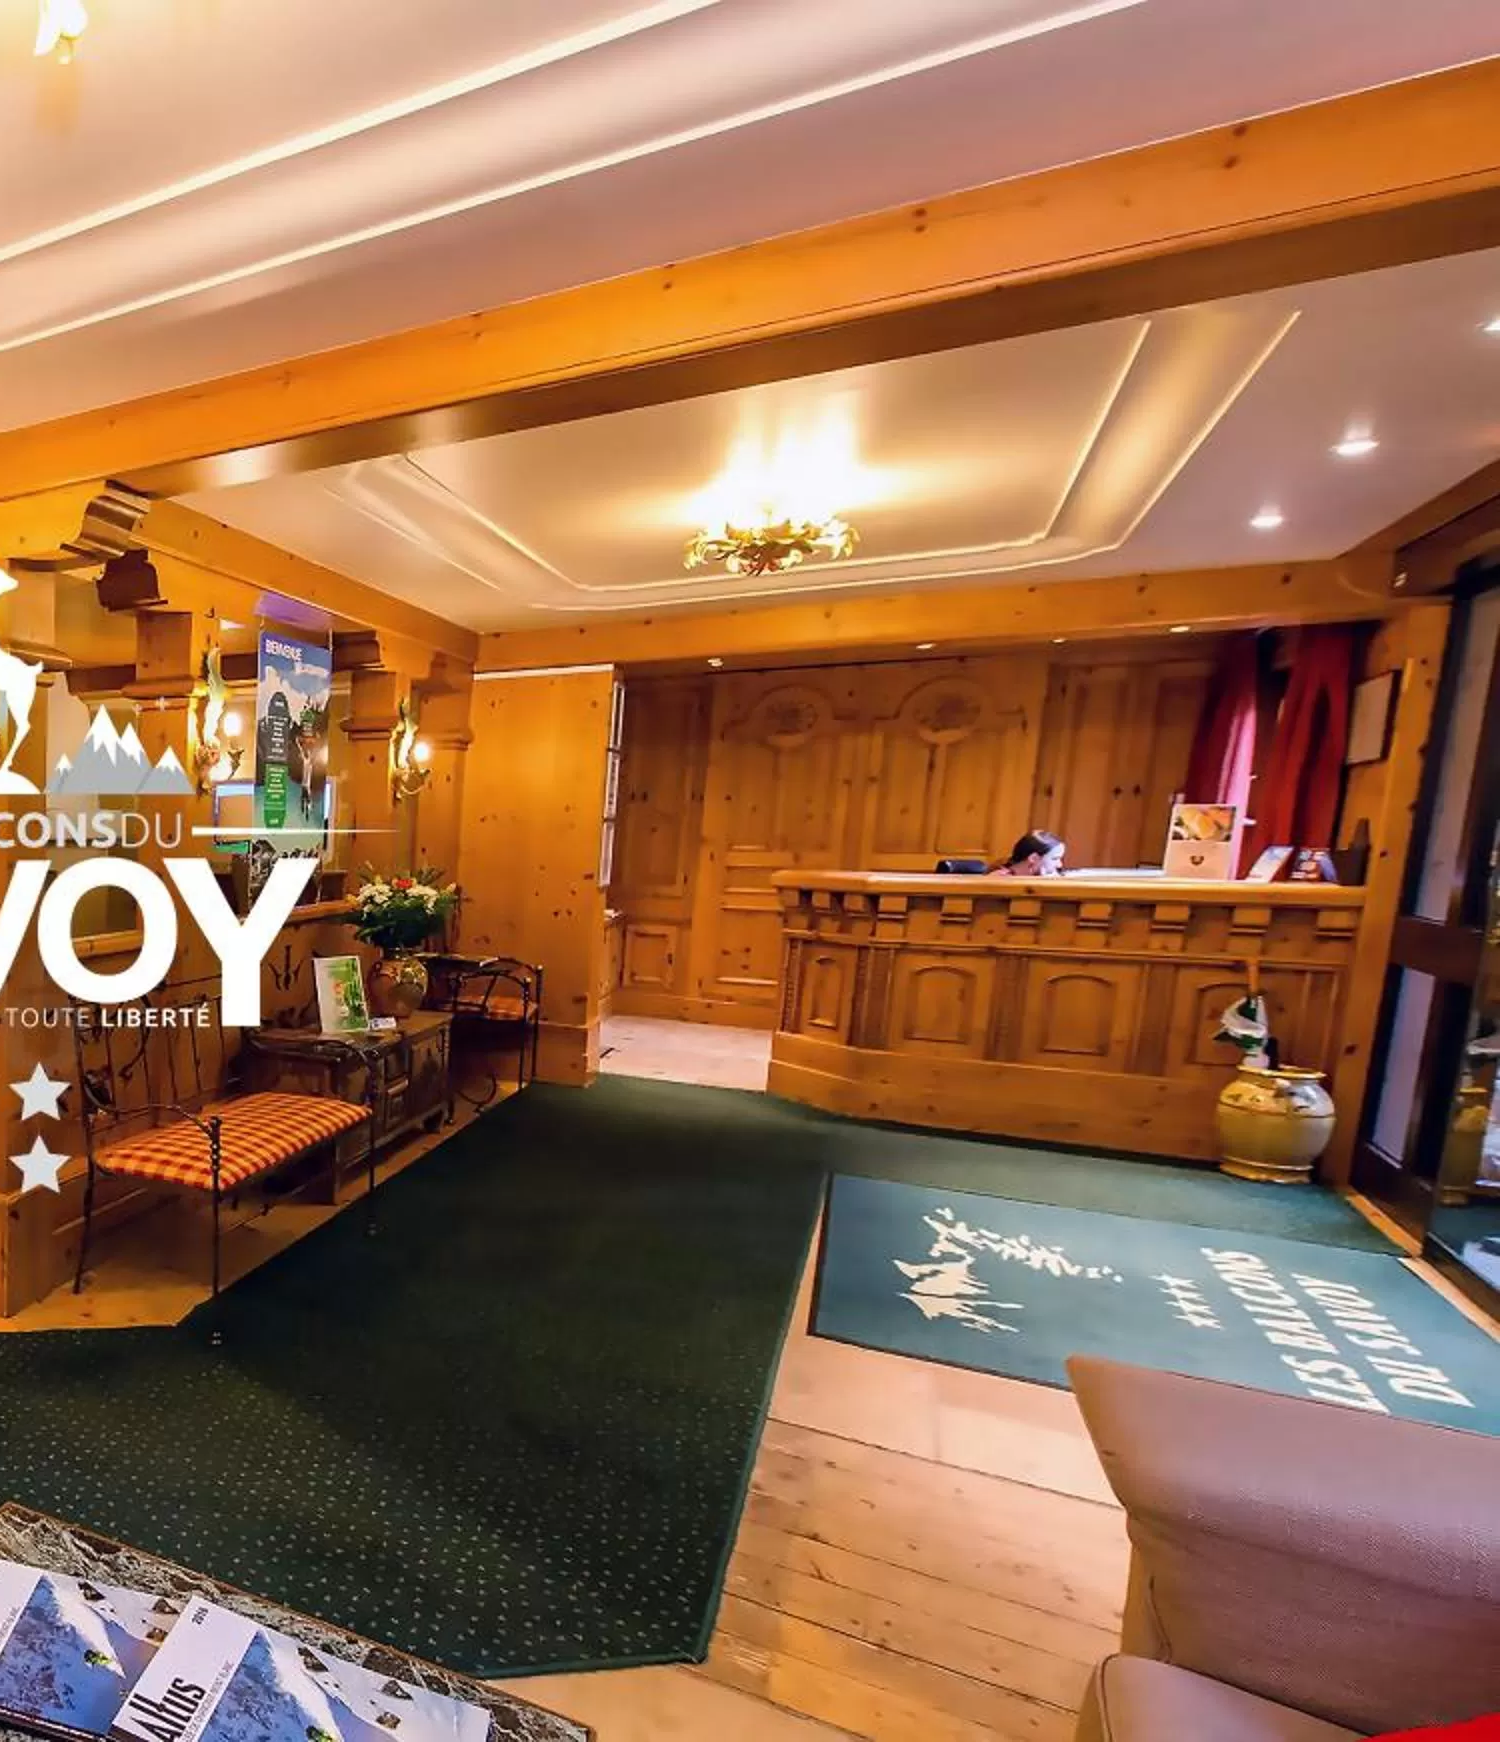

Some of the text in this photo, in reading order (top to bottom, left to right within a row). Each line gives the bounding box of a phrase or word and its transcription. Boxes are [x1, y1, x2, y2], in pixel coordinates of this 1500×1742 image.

[1200, 1247, 1392, 1416] LES BALCONS
[1290, 1273, 1477, 1409] DU SAVOY
[128, 1677, 206, 1742] Altus
